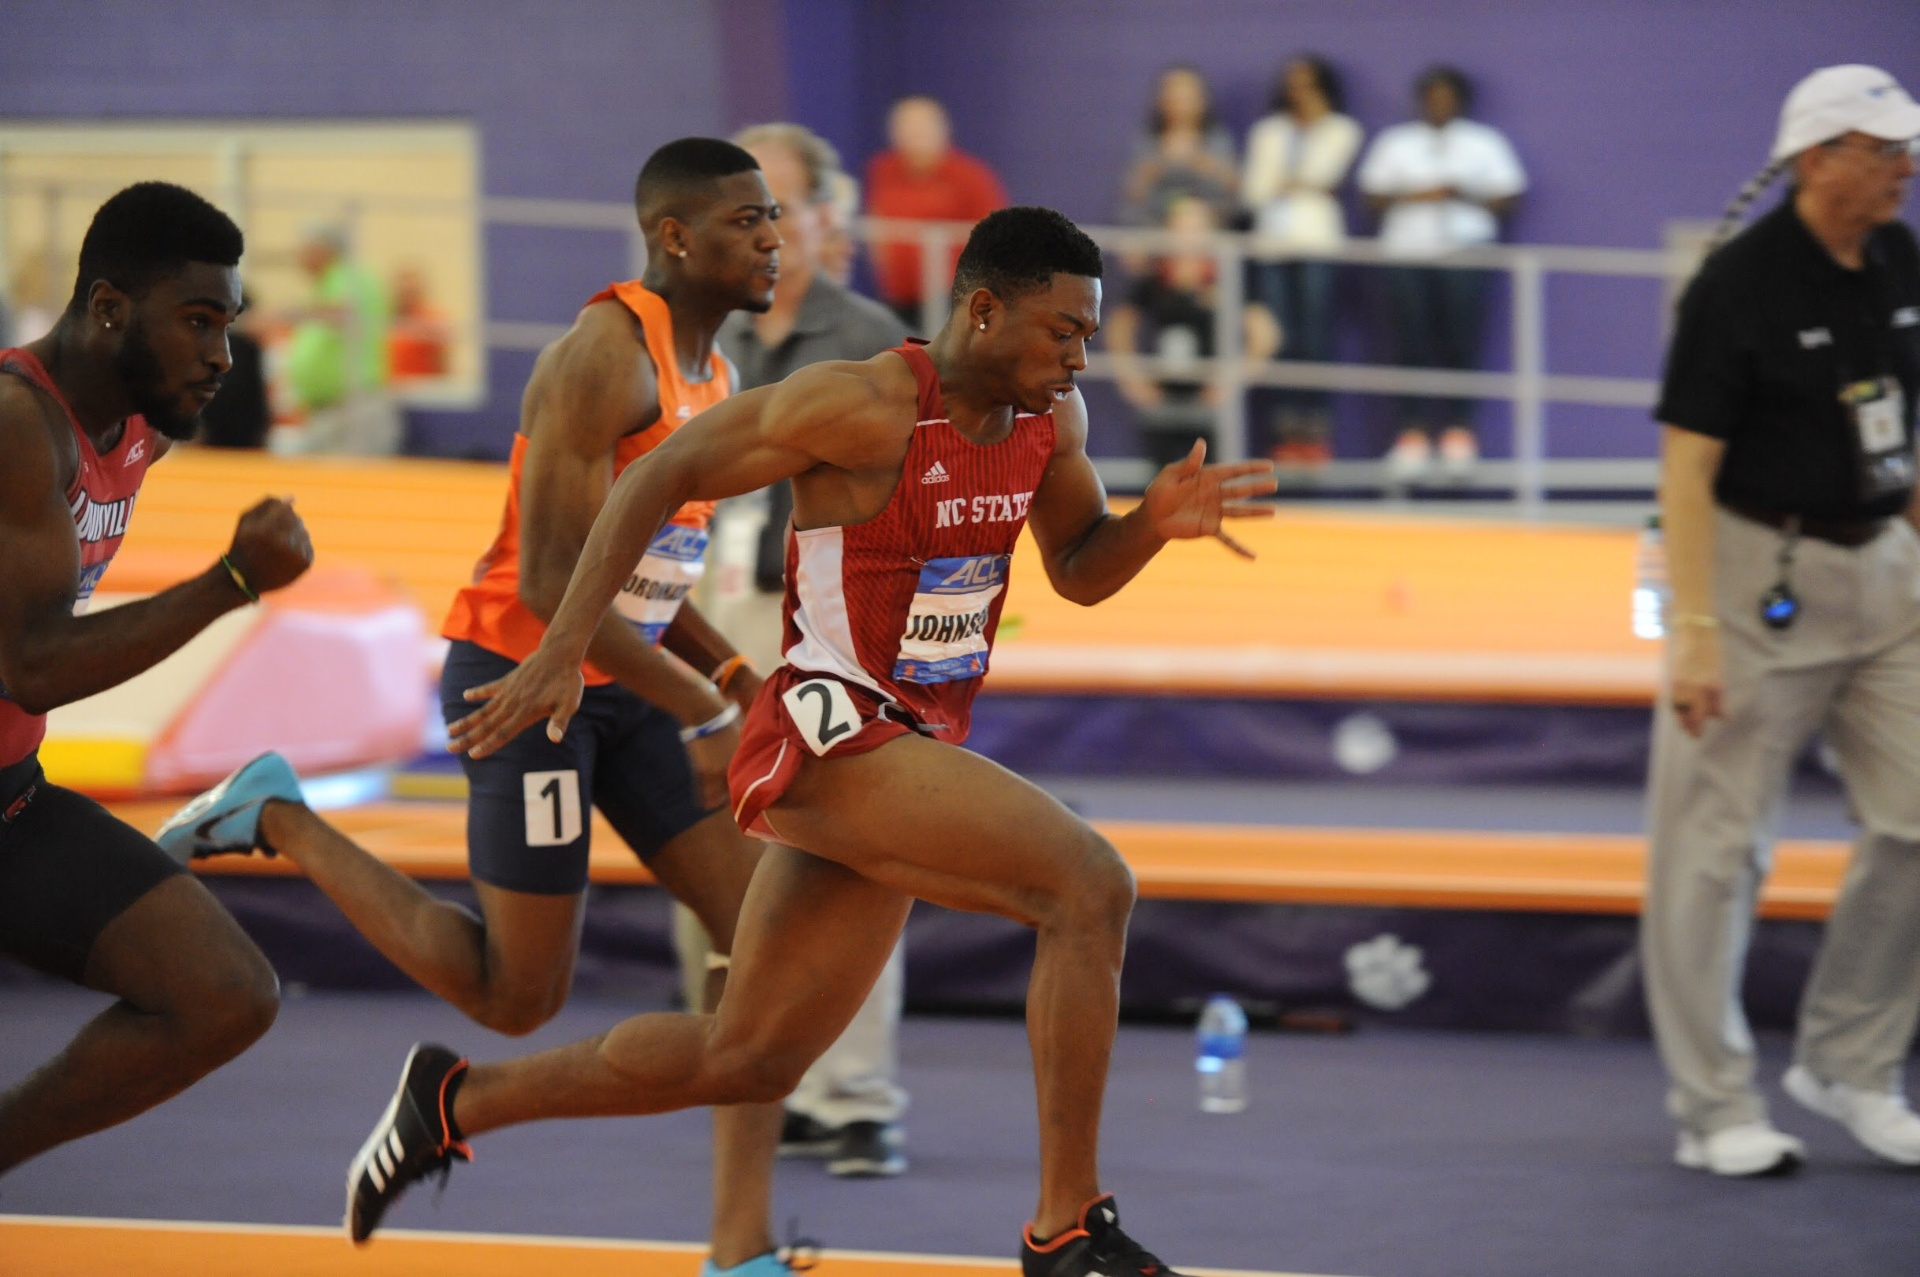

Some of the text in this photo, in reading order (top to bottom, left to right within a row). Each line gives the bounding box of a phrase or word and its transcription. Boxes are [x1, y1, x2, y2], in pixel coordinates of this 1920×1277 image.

[125, 438, 145, 464] ACC
[921, 474, 950, 485] adidas
[935, 490, 1034, 529] NC STATE
[940, 553, 1004, 586] ACC
[796, 682, 851, 746] 2
[540, 777, 562, 839] 1
